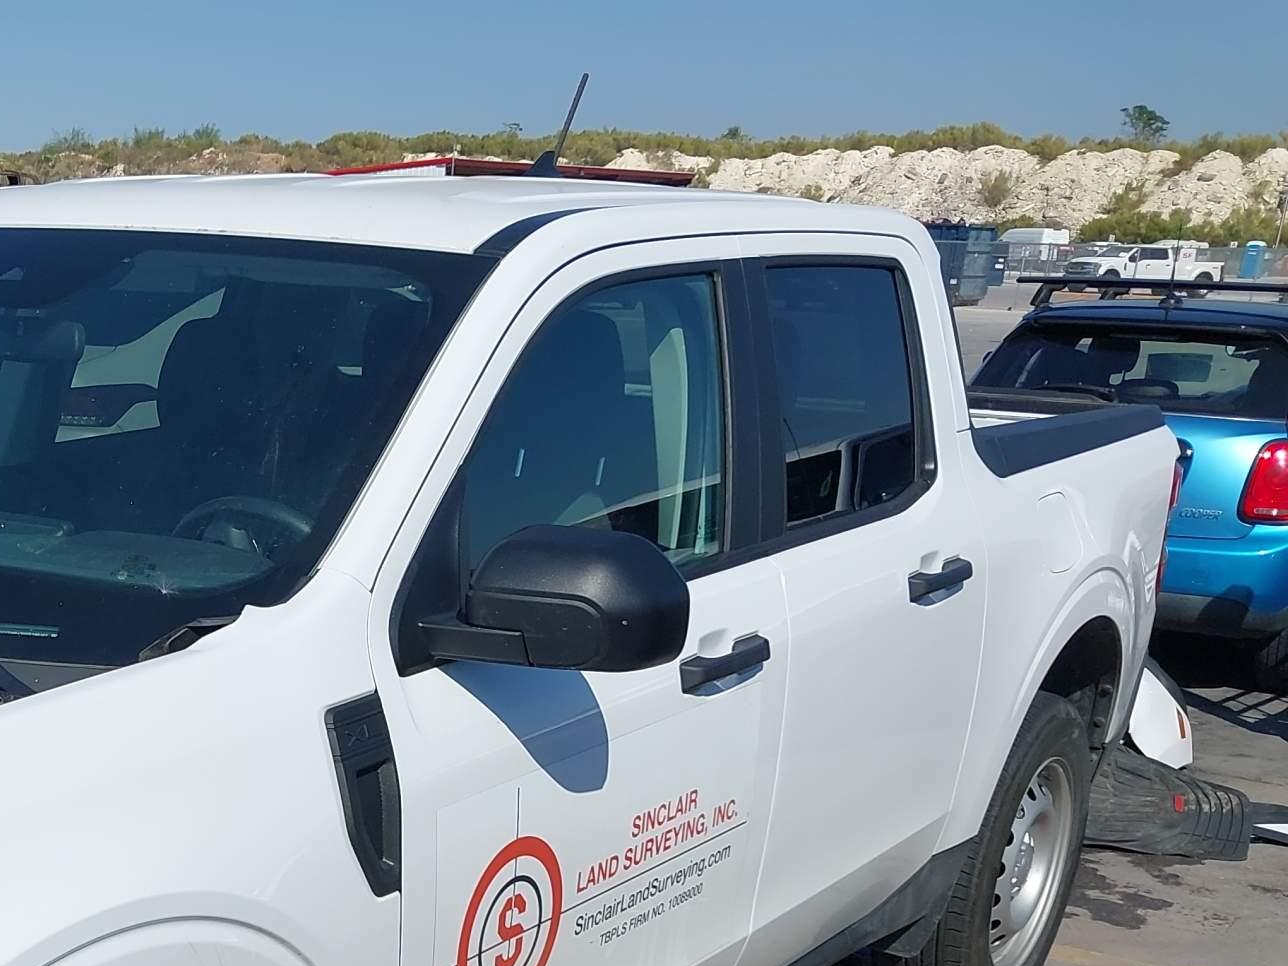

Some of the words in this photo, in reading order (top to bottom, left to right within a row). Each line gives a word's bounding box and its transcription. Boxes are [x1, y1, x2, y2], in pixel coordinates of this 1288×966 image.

[576, 855, 619, 894] LAND
[623, 813, 708, 871] SURVEYING,
[712, 799, 739, 828] INC.
[631, 788, 699, 838] SINCLAIR
[574, 845, 731, 936] SinclairLandSurveying.com
[599, 921, 627, 947] TBPLS
[628, 911, 650, 933] FIRM
[650, 901, 666, 920] NO.
